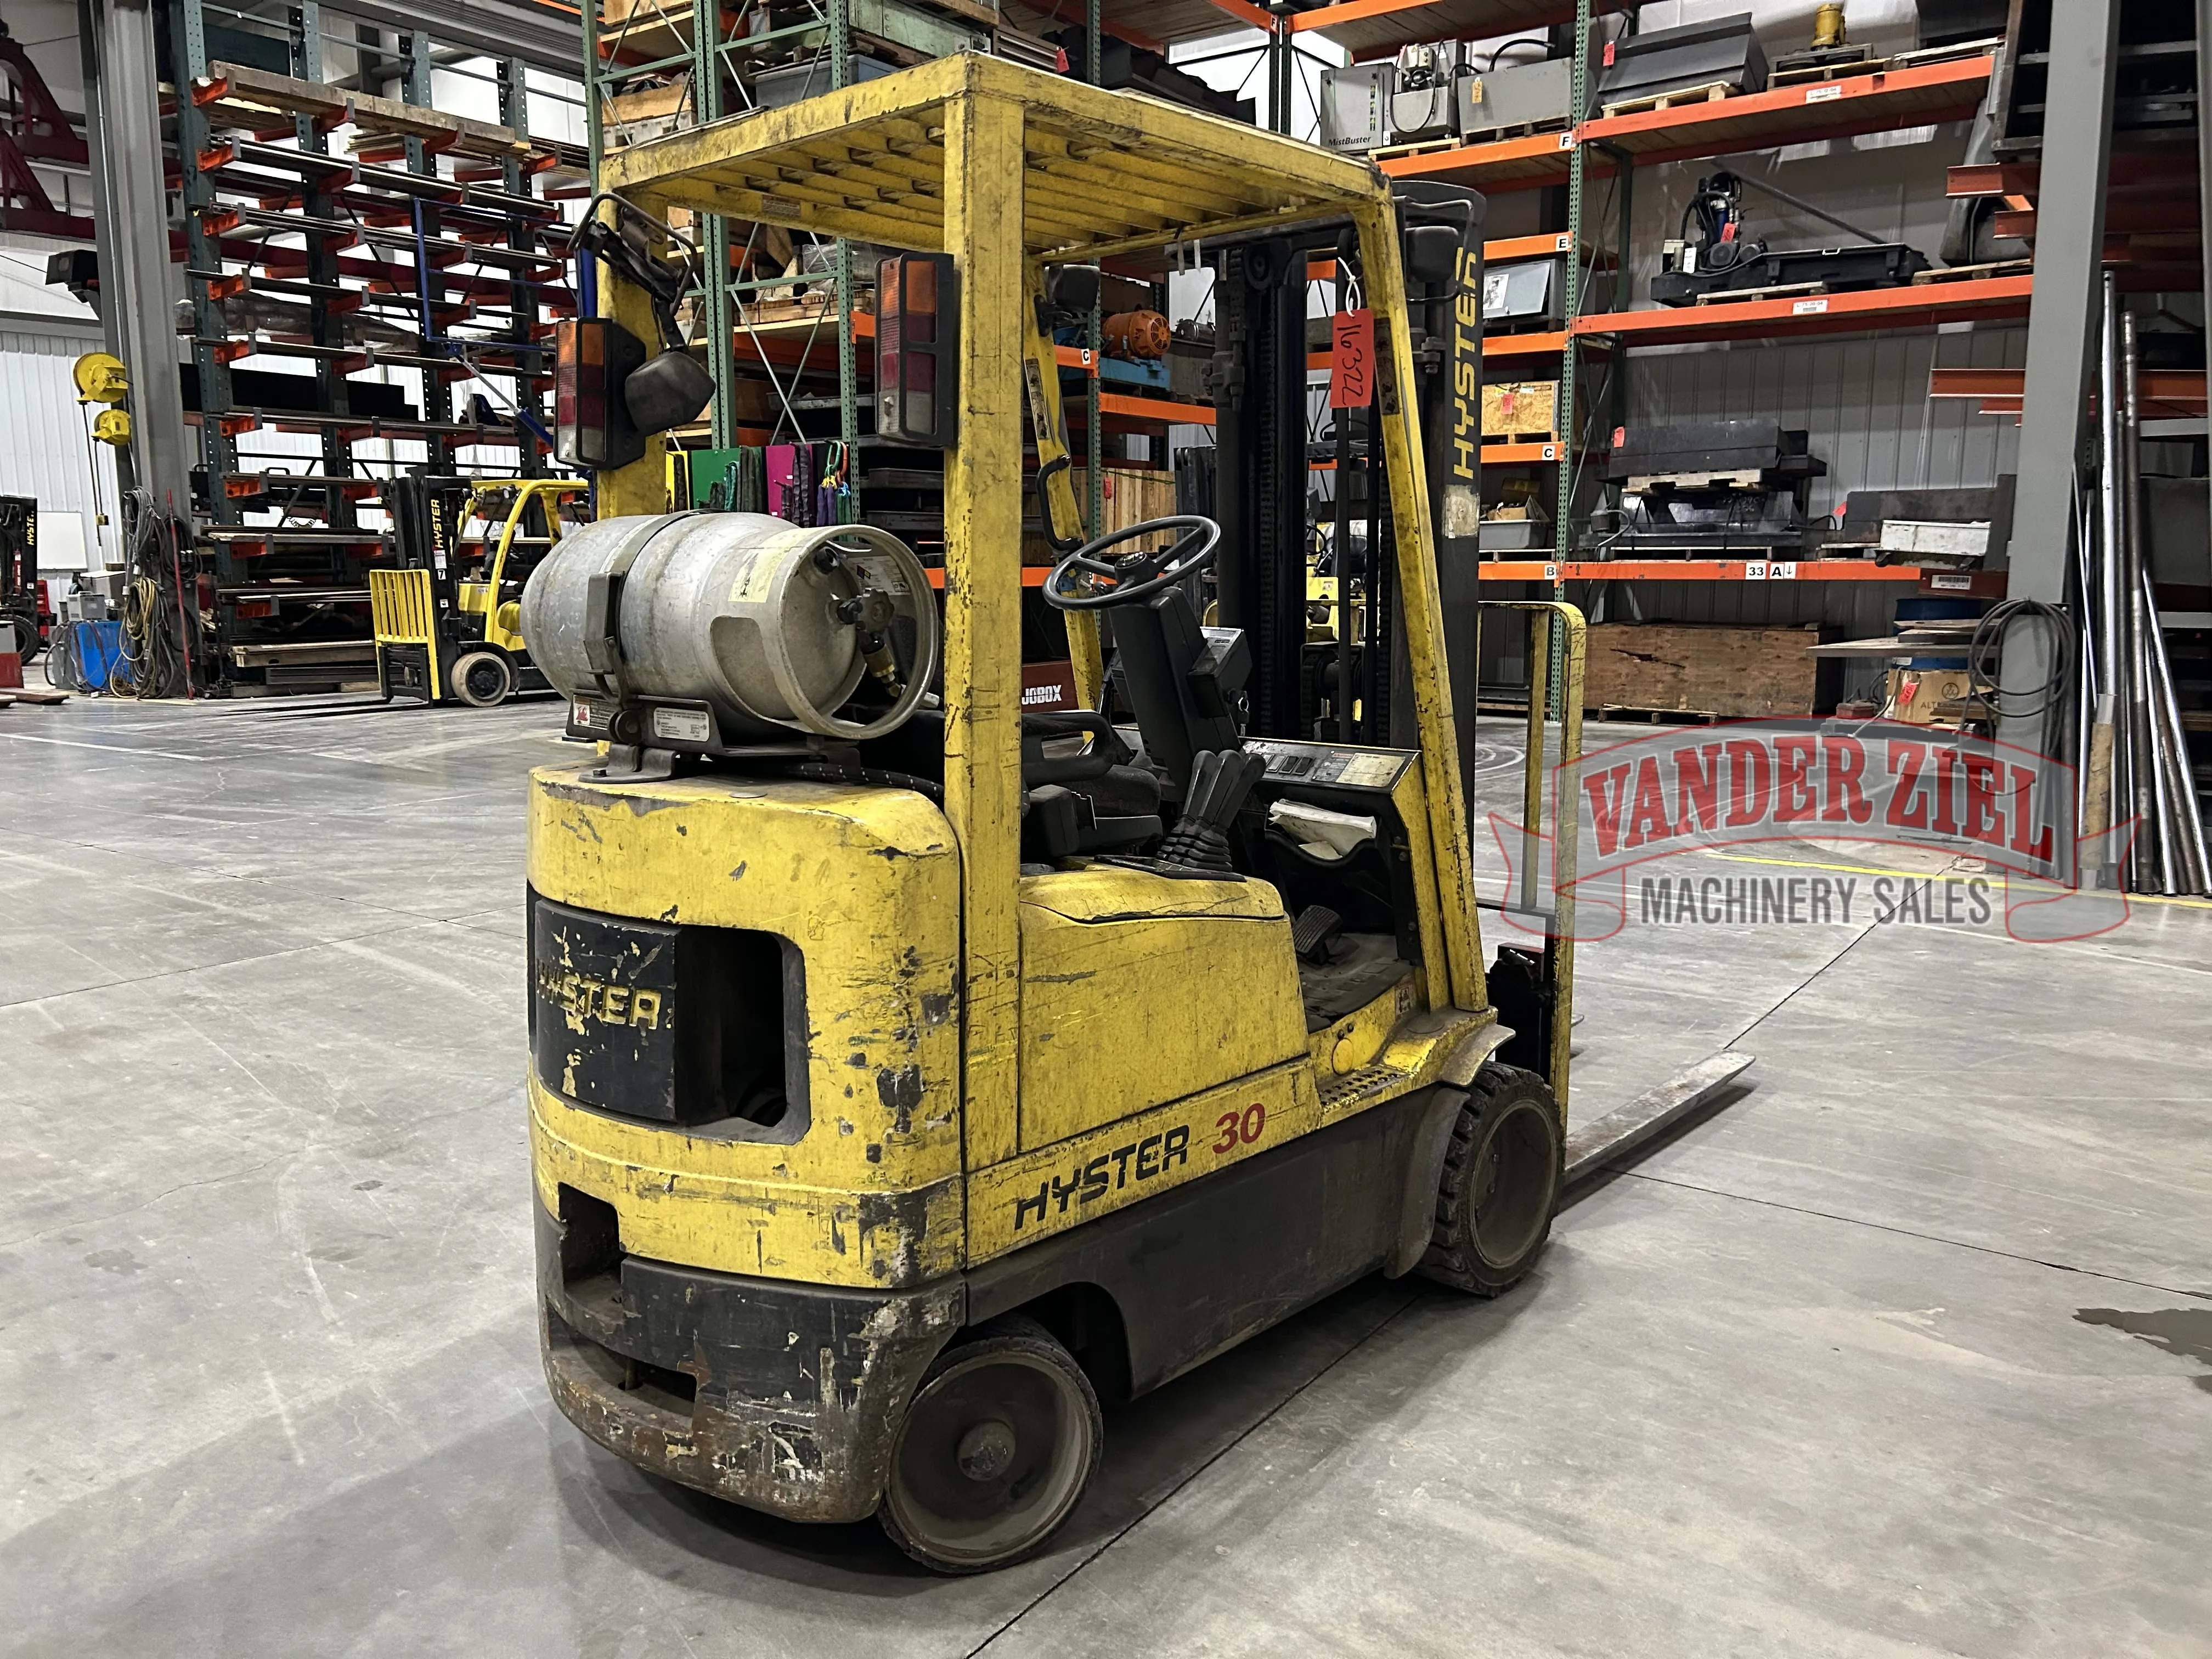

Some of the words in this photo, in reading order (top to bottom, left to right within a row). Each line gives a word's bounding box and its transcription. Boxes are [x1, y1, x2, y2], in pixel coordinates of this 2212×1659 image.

[1329, 136, 1371, 146] MistBuster
[1562, 136, 1570, 146] F
[1559, 239, 1566, 248] E
[1083, 350, 1089, 361] C
[1337, 324, 1363, 405] 16322
[1453, 247, 1476, 479] HYSTER
[1544, 448, 1553, 458] C
[431, 499, 444, 548] HYSTER
[439, 570, 443, 579] 7
[1547, 567, 1555, 576] B
[1748, 567, 1764, 575] 33
[1771, 566, 1782, 577] A
[1022, 685, 1062, 705] JOBOX
[536, 959, 662, 1030] STER
[1014, 1125, 1190, 1231] HYSTER
[1212, 1103, 1266, 1154] 30
